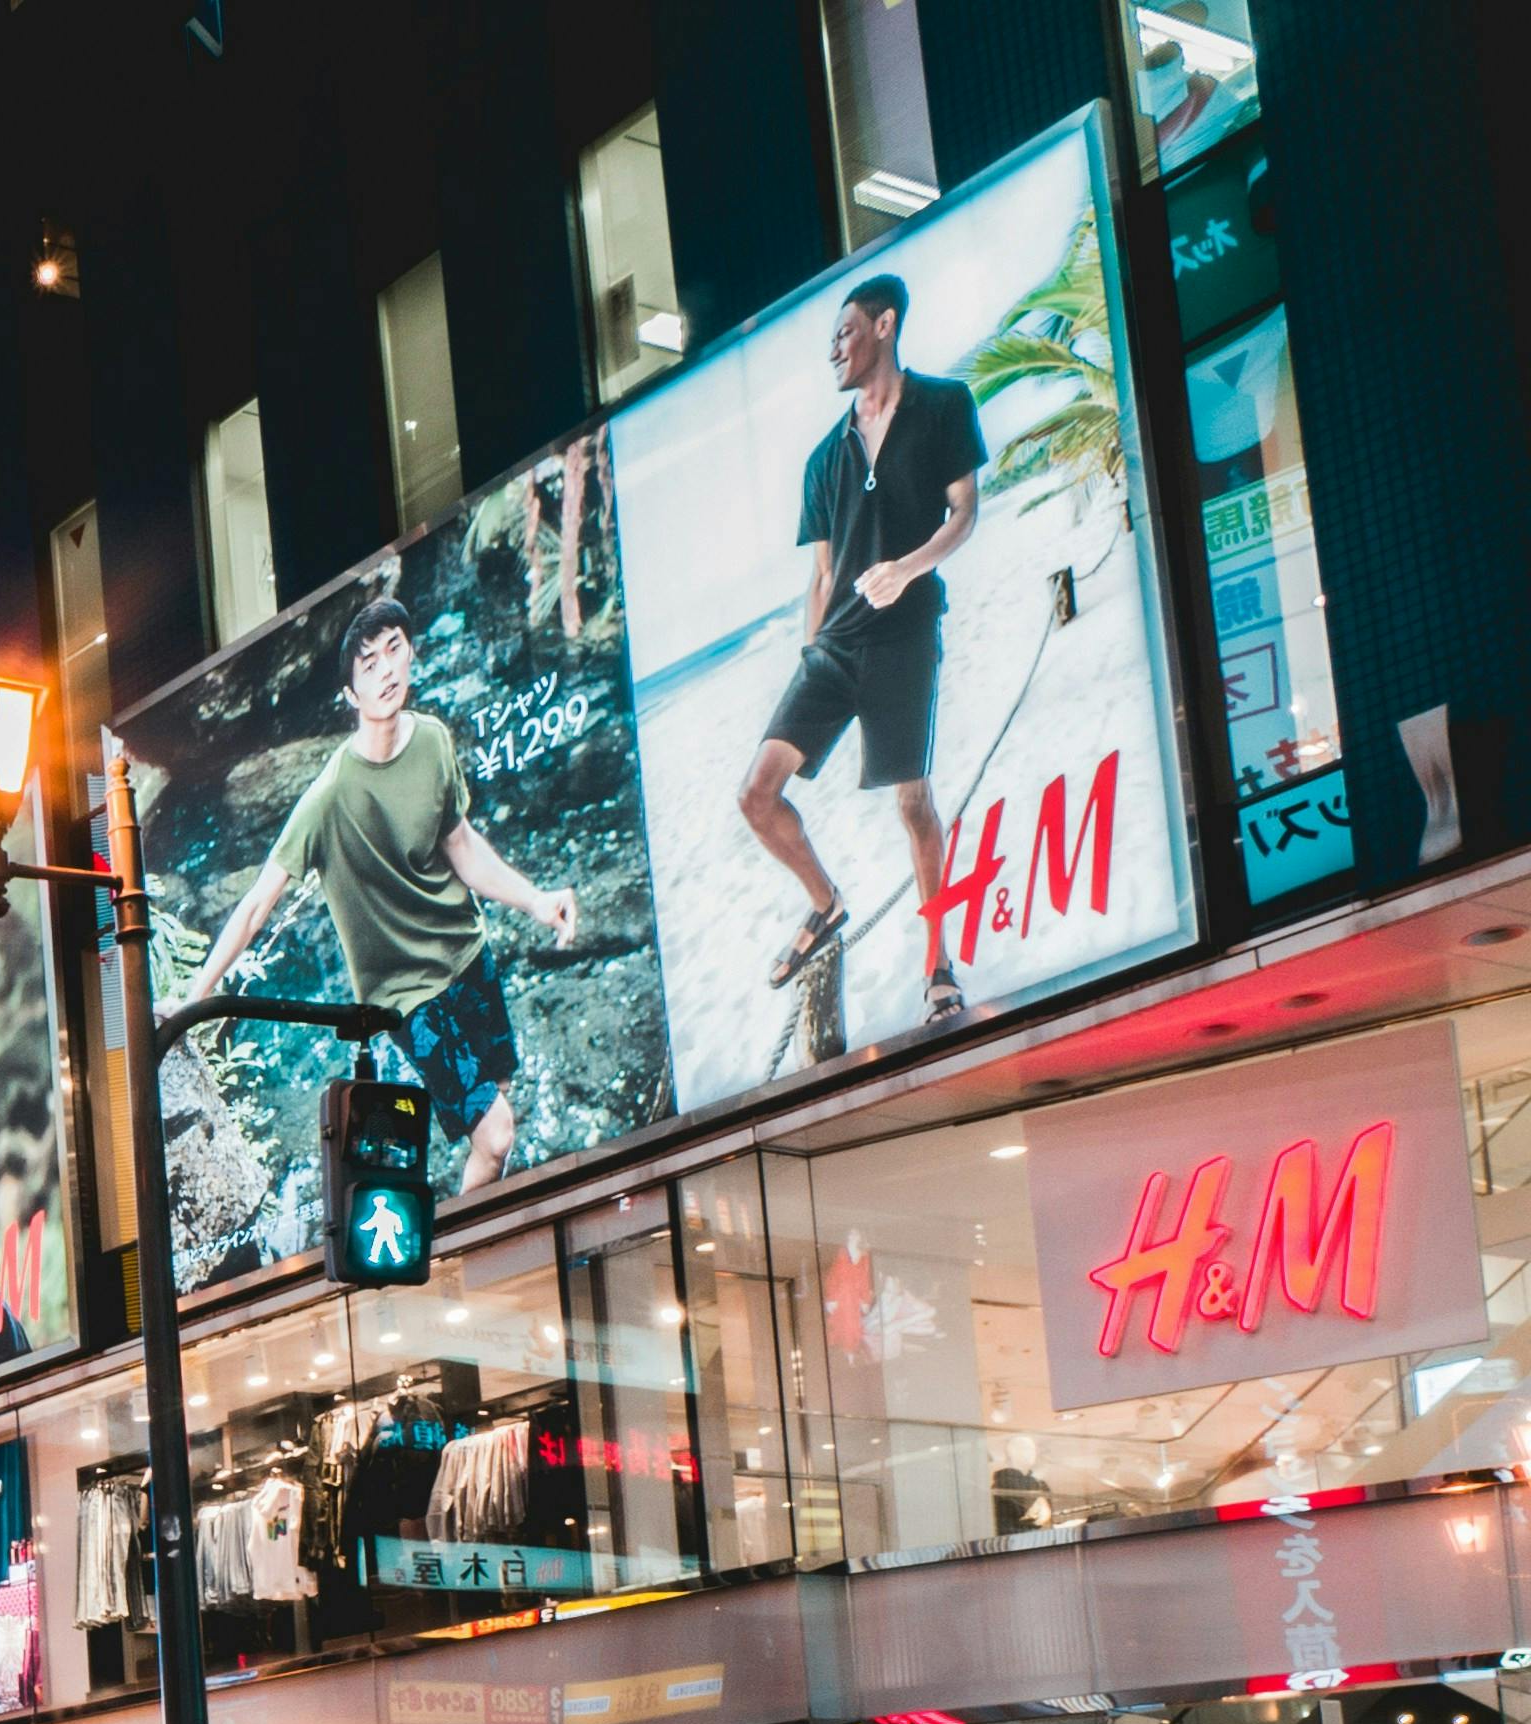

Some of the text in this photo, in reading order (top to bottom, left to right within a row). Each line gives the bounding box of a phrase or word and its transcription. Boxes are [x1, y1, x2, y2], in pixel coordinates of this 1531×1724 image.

[471, 671, 558, 733] Tシャツ
[476, 696, 589, 781] ¥1,299
[917, 749, 1119, 978] H&M
[1089, 1119, 1395, 1357] H&M
